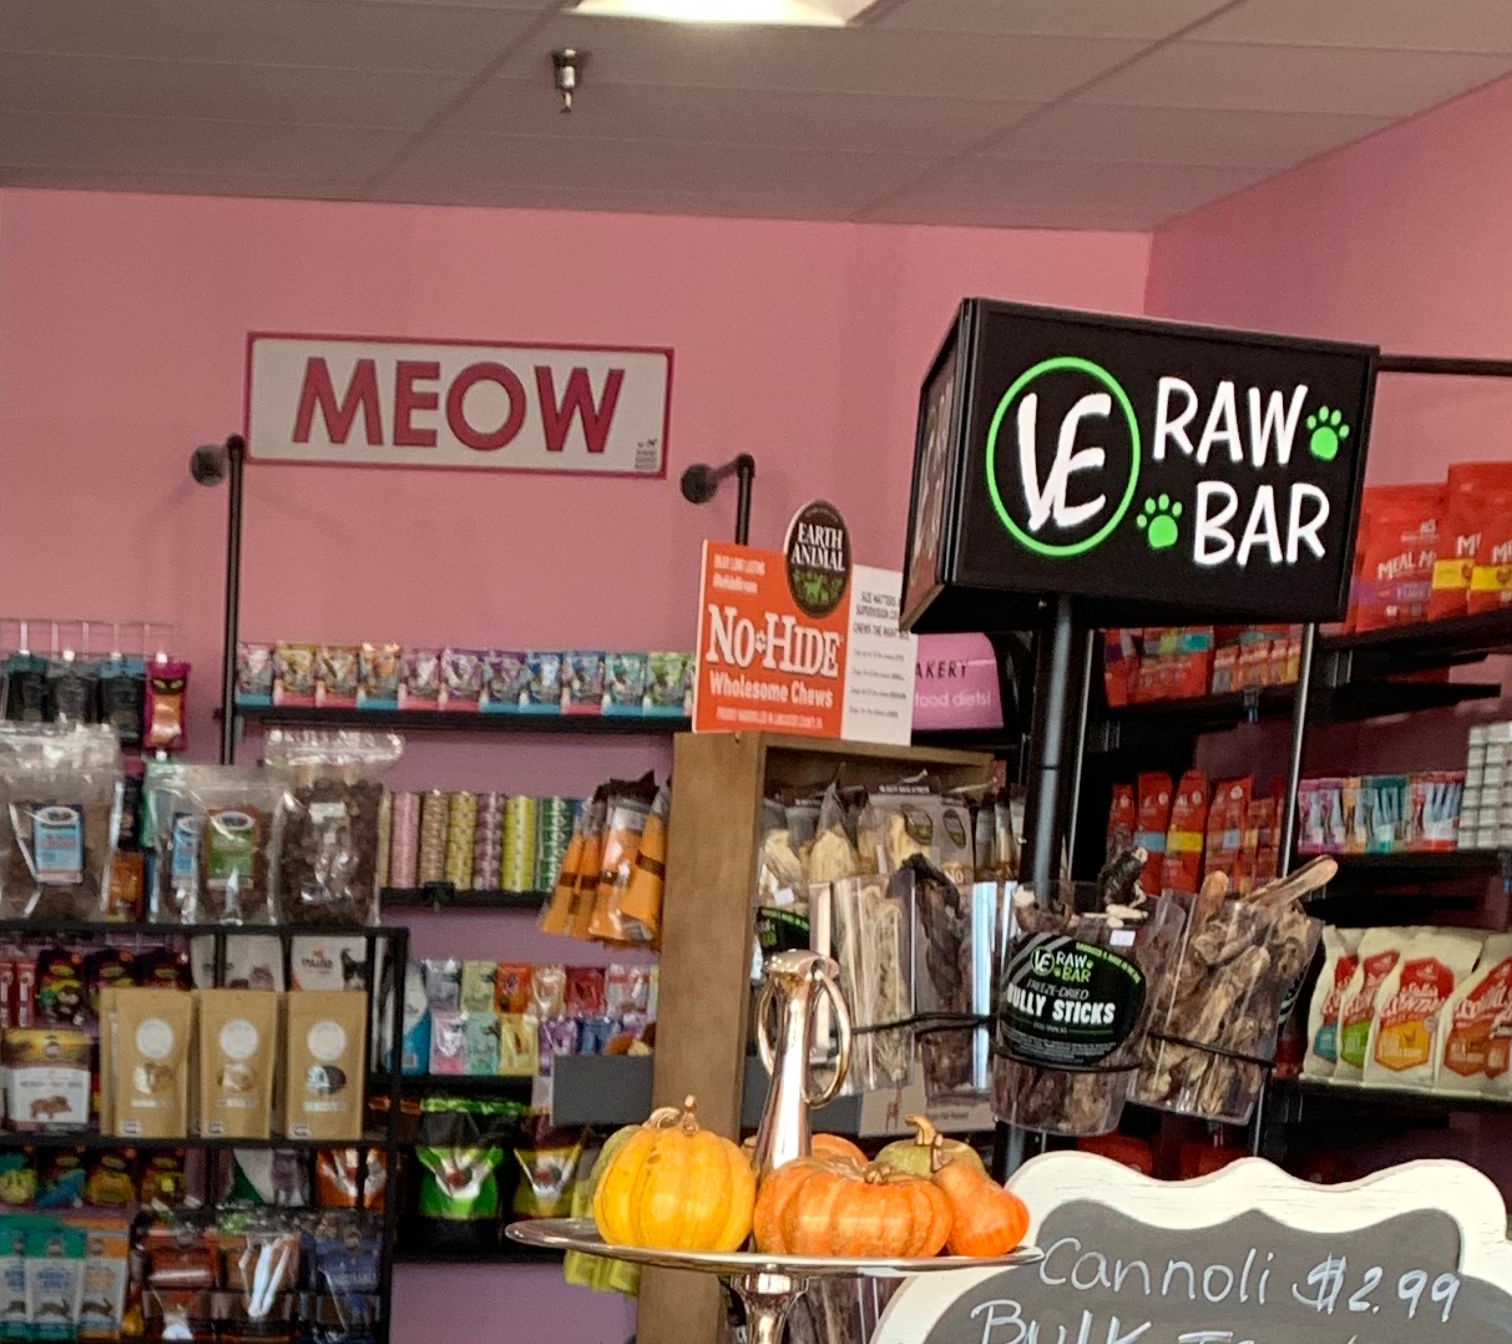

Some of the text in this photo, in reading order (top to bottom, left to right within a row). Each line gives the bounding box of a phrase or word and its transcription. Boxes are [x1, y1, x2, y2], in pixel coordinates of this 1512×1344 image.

[292, 356, 625, 454] MEOW
[1152, 376, 1308, 468] RAW
[797, 521, 843, 550] EARTH
[1193, 480, 1330, 567] BAR
[790, 546, 846, 572] ANIMAL
[915, 659, 968, 679] AKERY
[709, 670, 833, 708] Wholesome Chews
[1055, 951, 1088, 969] RAW
[1062, 968, 1091, 983] BAR
[1052, 999, 1116, 1025] STICKS
[1039, 1236, 1461, 1323] Cannoli $2.99
